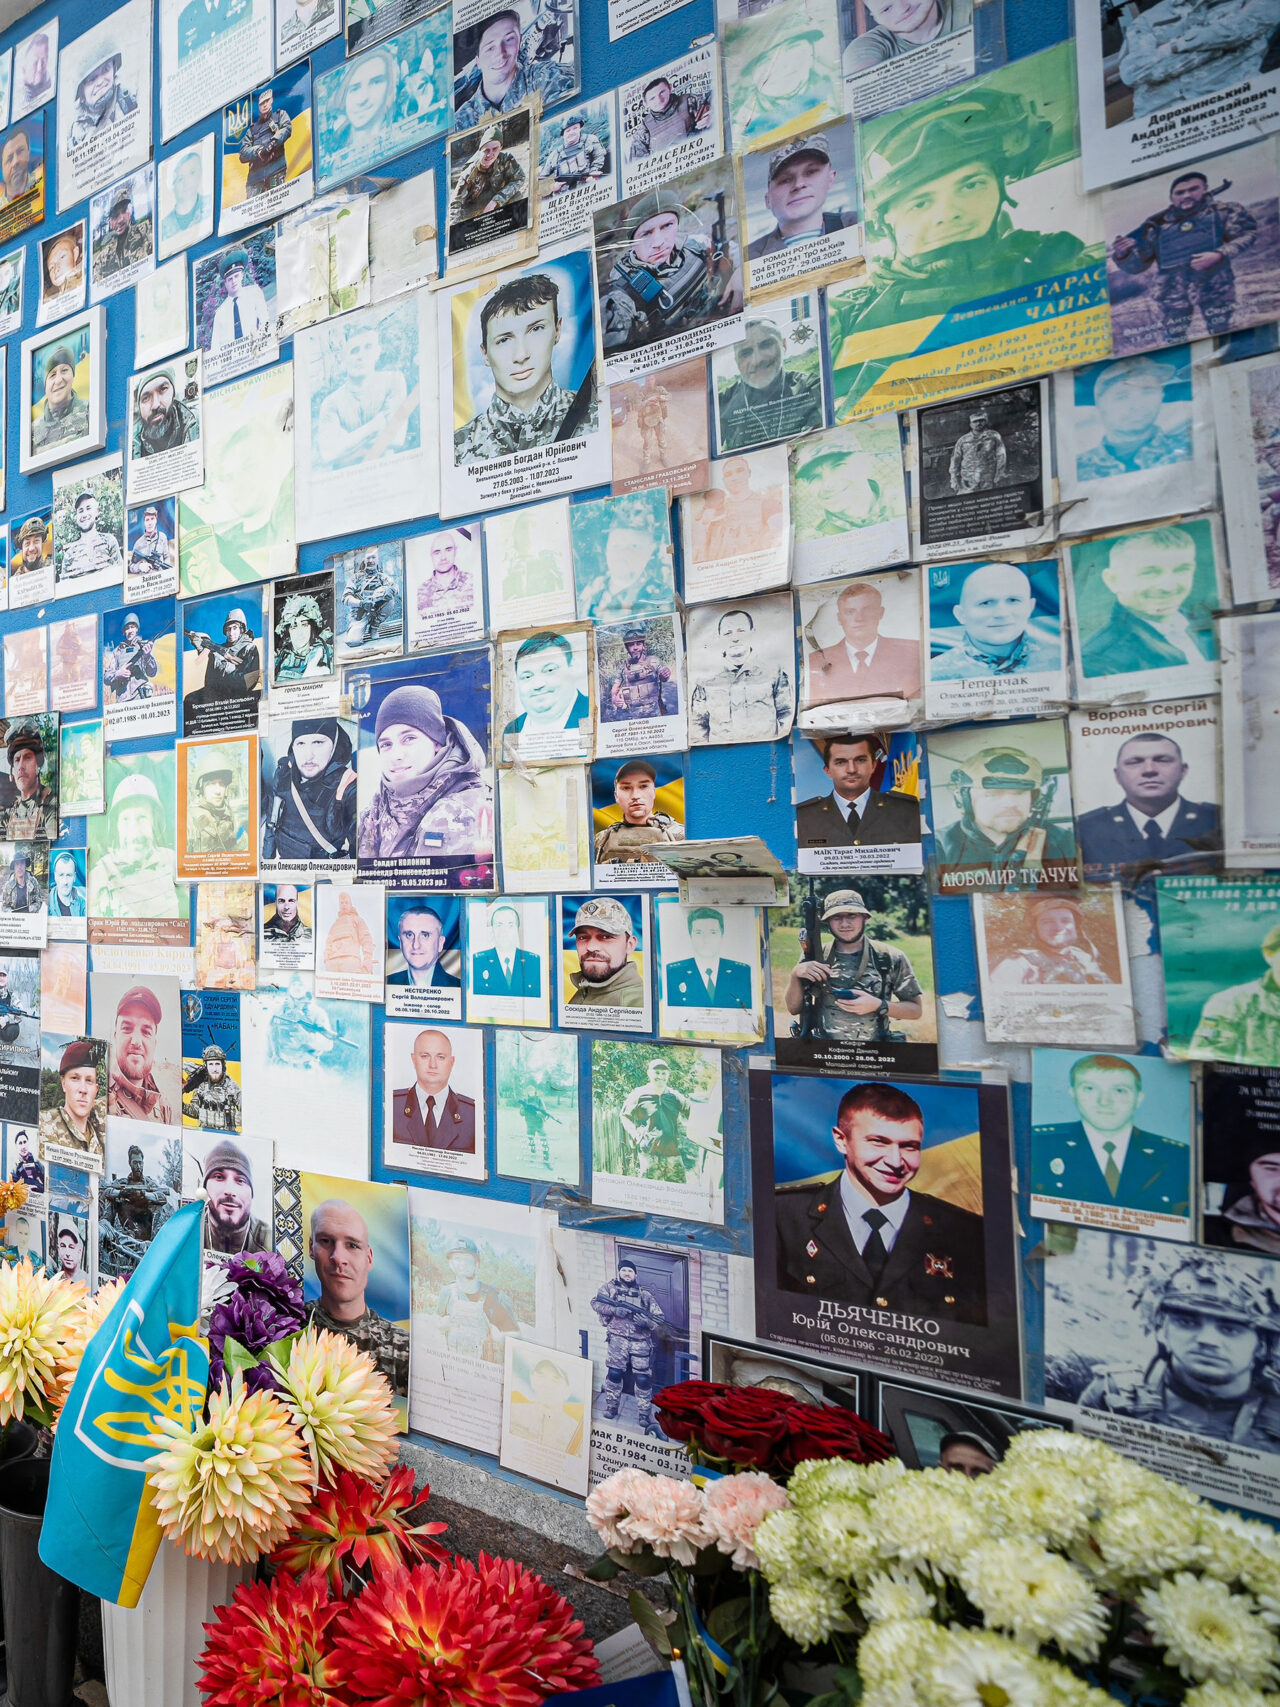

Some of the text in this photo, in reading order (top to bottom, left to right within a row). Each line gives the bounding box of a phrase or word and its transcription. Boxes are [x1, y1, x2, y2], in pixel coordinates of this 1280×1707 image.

[1130, 86, 1277, 143] Андрій Миколайович
[1148, 81, 1251, 127] Дорожинський
[1140, 101, 1268, 150] 29.01.1976 3.11.2022
[66, 141, 88, 158] Шульга
[637, 138, 703, 173] ТАРАСЕНКО
[626, 143, 715, 184] Олександр Ігорович
[628, 152, 715, 191] 01.12.1992 21.05.2022
[548, 183, 597, 209] ЩЕРБИНА
[569, 185, 613, 208] Вікторович
[751, 267, 765, 276] 204
[766, 260, 787, 272] БТРО
[788, 255, 801, 264] 241
[804, 249, 819, 259] ТрО
[763, 237, 830, 264] РОМАН РОТАНОВ
[755, 248, 842, 282] 01.03.1977 29.08.2022
[950, 267, 1108, 324] Лейтенант ТАРАС
[1025, 287, 1109, 319] ЧАЙКА
[1042, 310, 1110, 337] 02.11.202
[630, 342, 663, 361] ВІТАЛІЙ
[665, 316, 742, 347] ВОЛОДИМИРОВИЧ
[890, 333, 1067, 388] Командир розвідувального
[467, 440, 587, 477] Марченков Богдан Юрійович
[493, 467, 560, 490] 27.05.2003 11.07.2023
[939, 685, 1051, 701] Олександр Васильович
[959, 675, 1029, 690] Тепенчак
[141, 709, 171, 720] 01.01.2023
[1088, 700, 1208, 722] Ворона Сергій
[1081, 716, 1219, 738] Володимирович
[373, 859, 398, 867] Солдат
[813, 846, 901, 856] МАЇК Тарас Михайлович
[260, 861, 276, 871] Браун
[277, 861, 308, 872] Олександр
[309, 861, 356, 872] Олександрович
[942, 866, 1079, 888] ЛЮБОМИР ТКАЧУК
[817, 1300, 940, 1336] ДЬЯЧЕНКО
[792, 1312, 971, 1359] Юрій Олександрович
[820, 1332, 945, 1367] (05.02.1996 26.02.2022)
[590, 1439, 647, 1462] 02.05.1984
[616, 1433, 671, 1457] В'ячеслав
